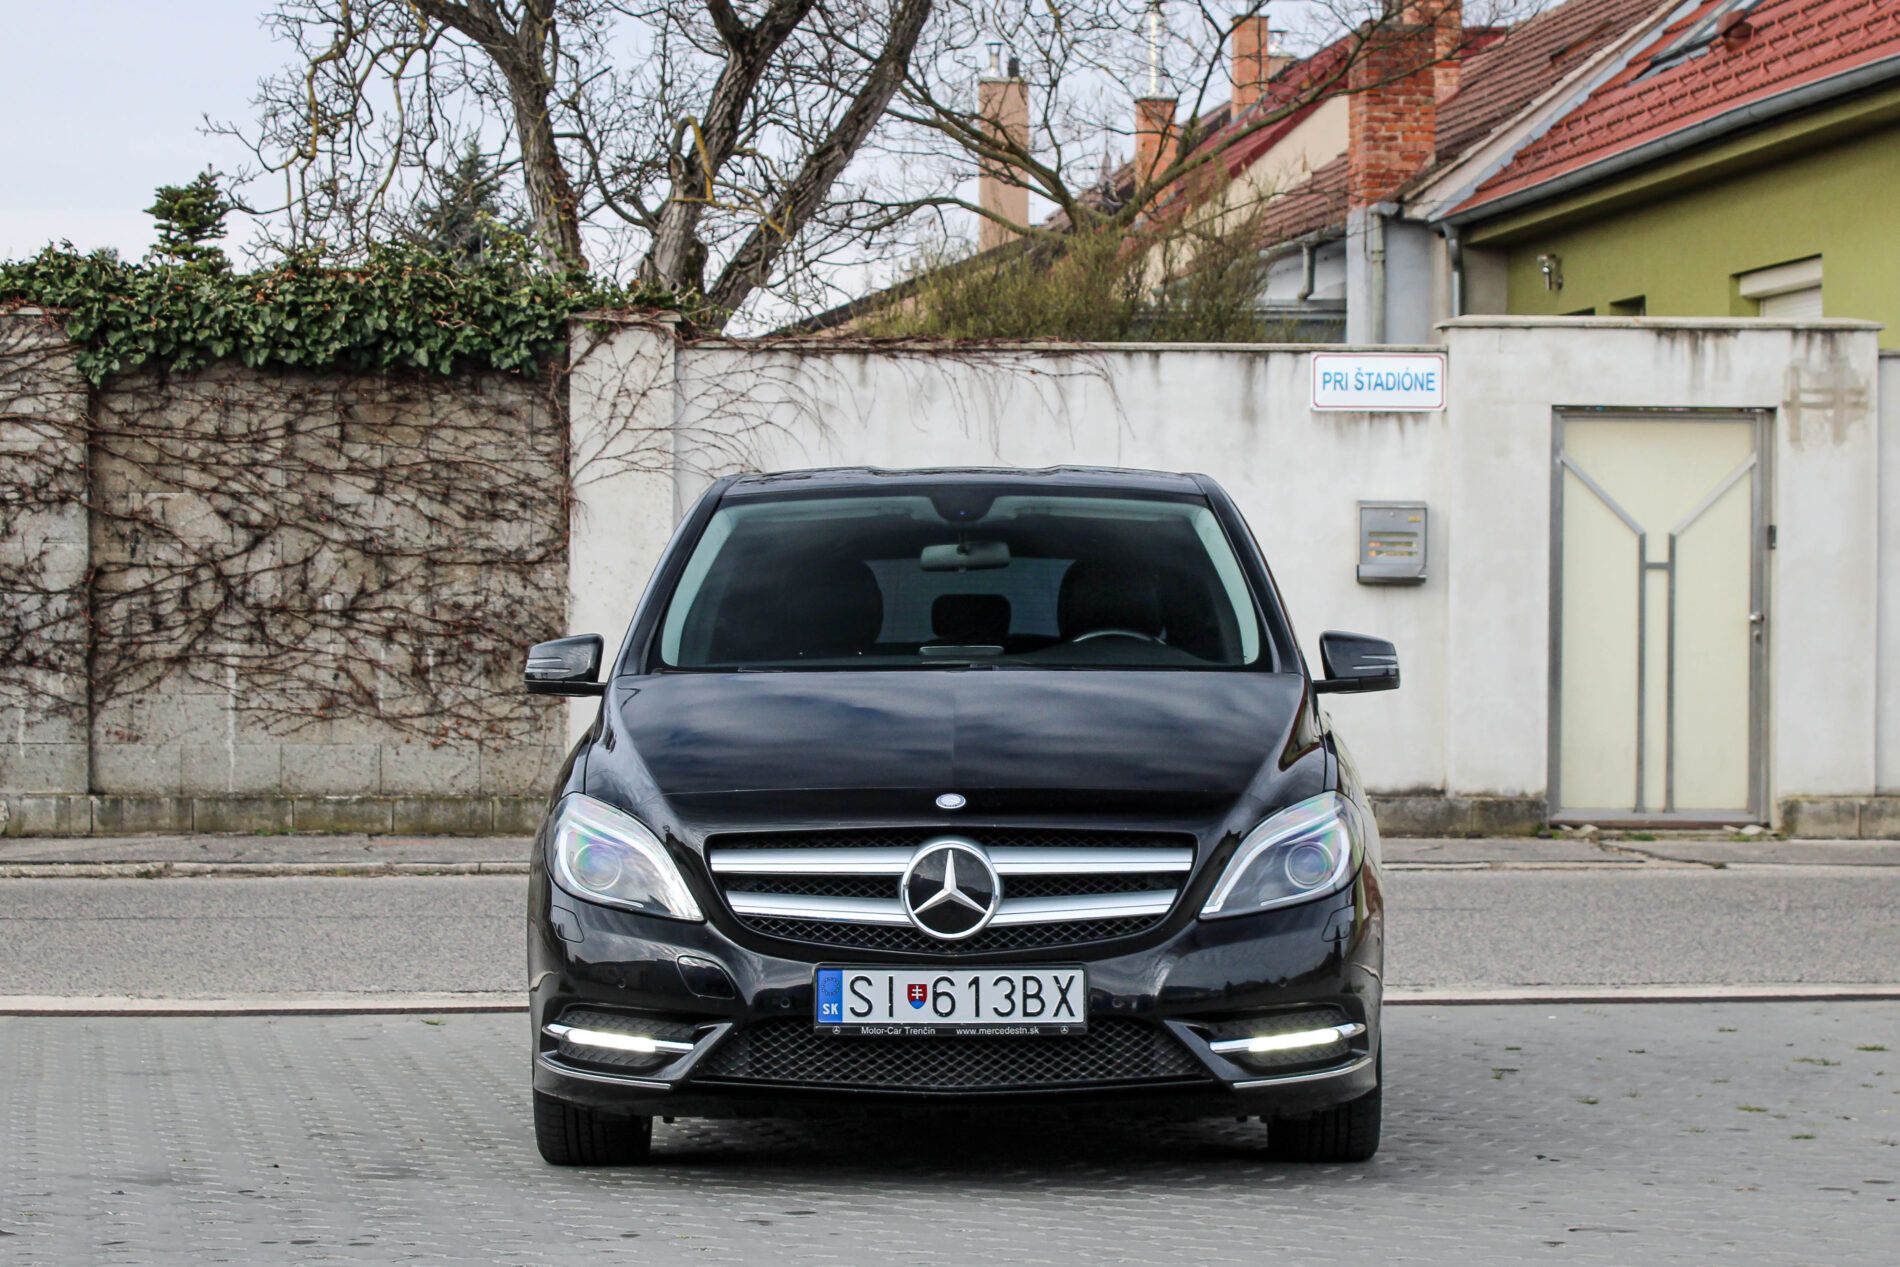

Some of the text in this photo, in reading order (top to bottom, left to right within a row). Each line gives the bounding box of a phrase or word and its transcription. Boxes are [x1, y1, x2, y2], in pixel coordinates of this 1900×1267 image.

[1322, 367, 1436, 392] PRI ŠTADIÓNE
[849, 975, 1075, 1018] SI 613BX
[822, 1003, 838, 1015] SK
[861, 1026, 902, 1035] Motor-Car
[956, 1026, 1040, 1035] www.mercedestn.sk
